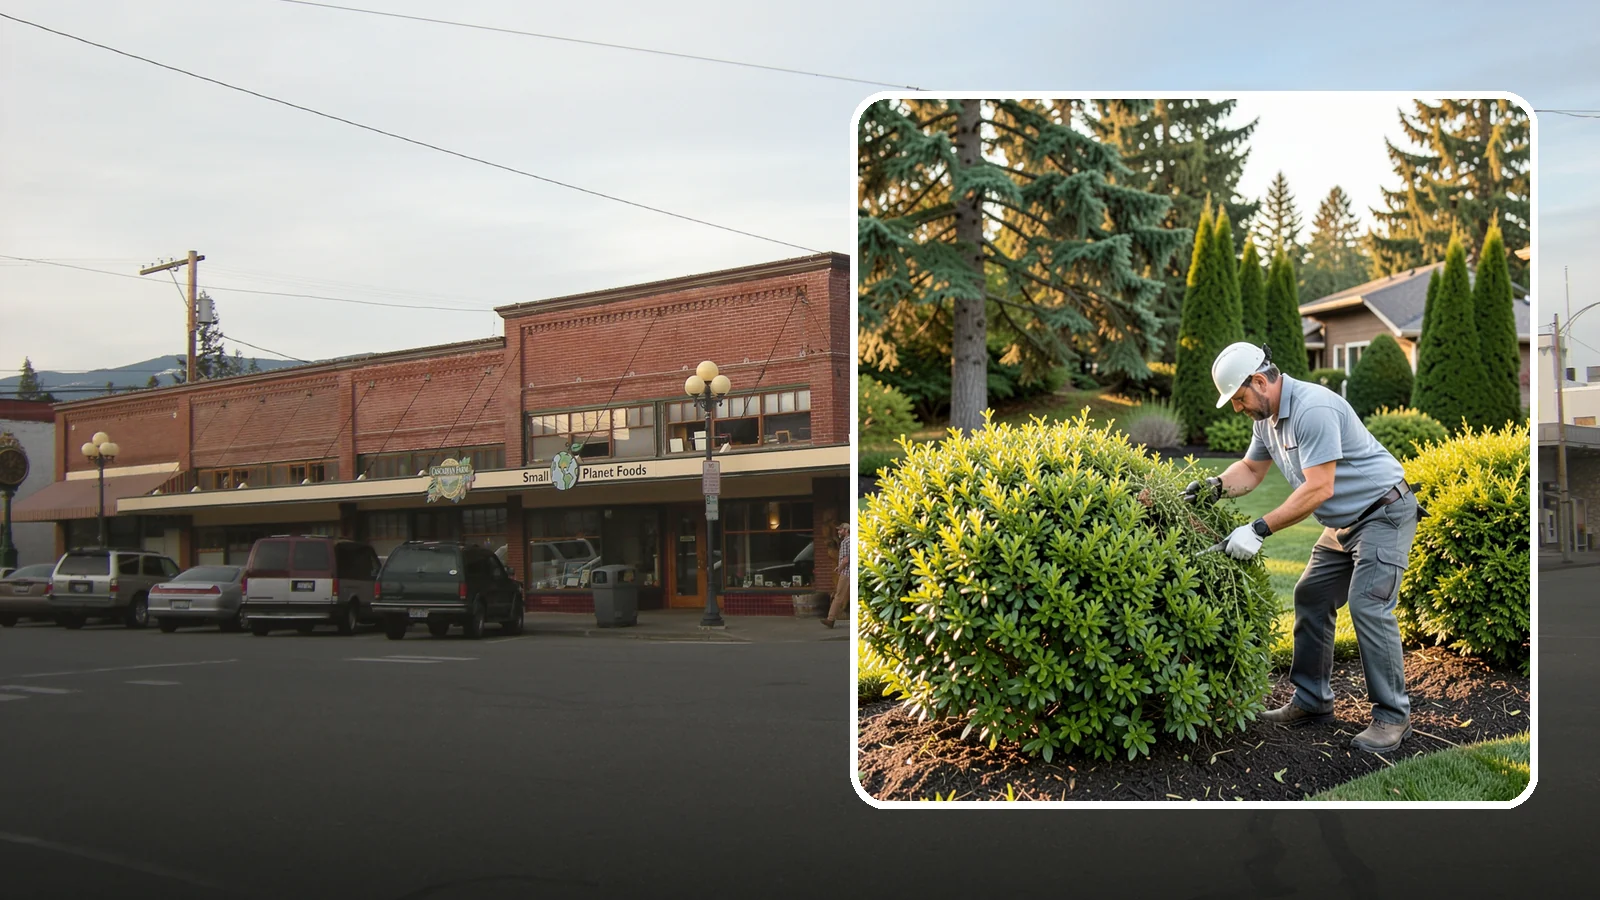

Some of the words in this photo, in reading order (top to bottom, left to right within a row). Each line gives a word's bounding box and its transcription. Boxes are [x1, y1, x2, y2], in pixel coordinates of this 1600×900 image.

[523, 471, 548, 483] Small
[583, 466, 614, 479] Planet
[617, 464, 647, 477] Foods
